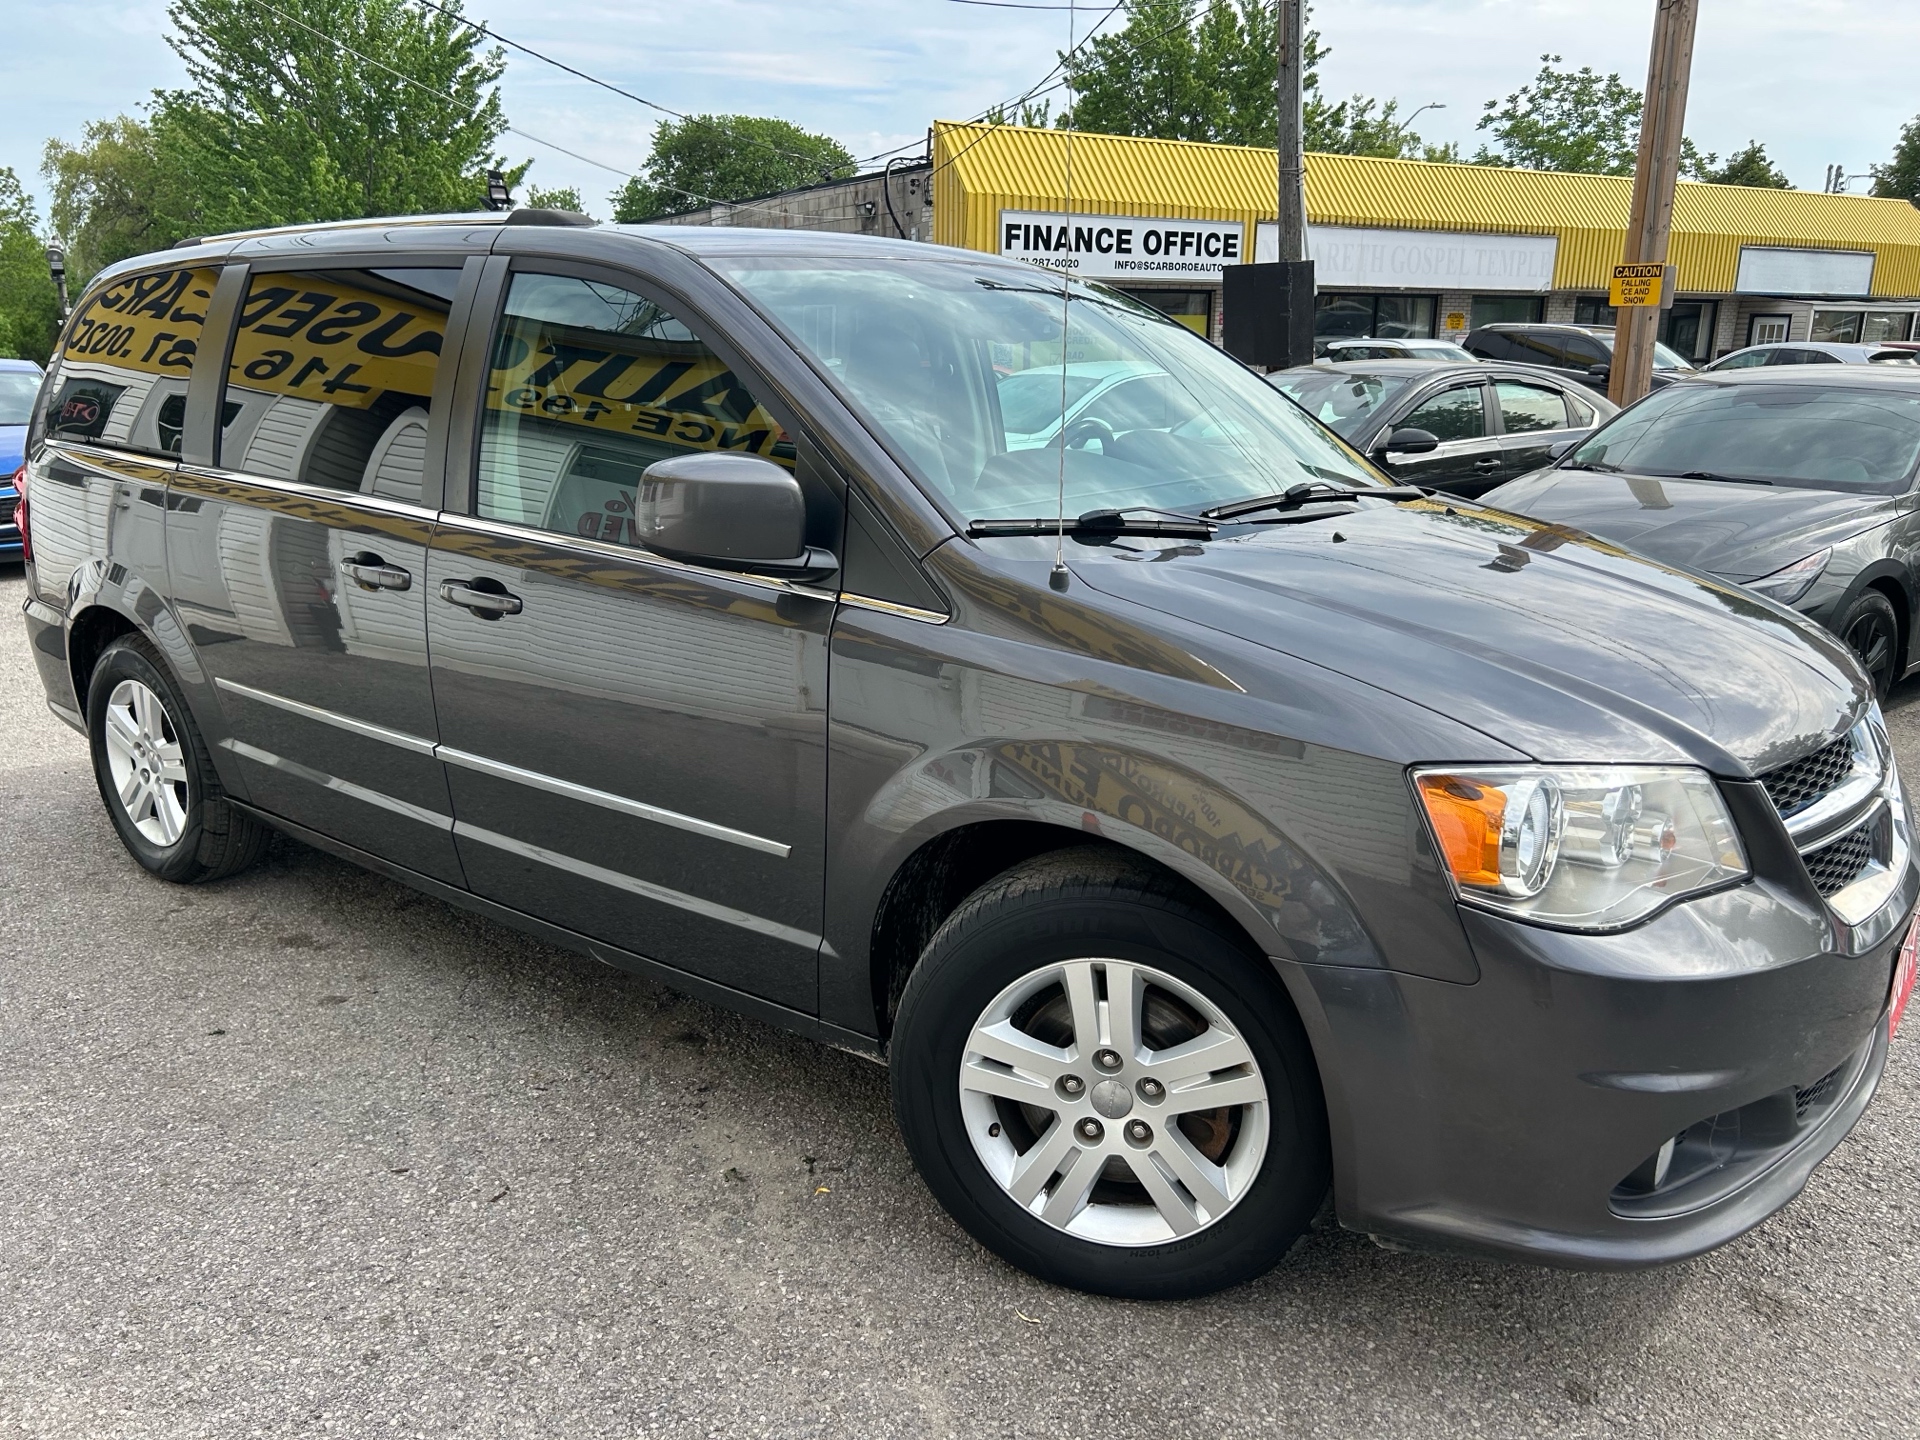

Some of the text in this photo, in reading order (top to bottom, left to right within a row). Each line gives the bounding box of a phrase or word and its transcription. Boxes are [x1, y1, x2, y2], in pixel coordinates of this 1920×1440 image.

[1005, 223, 1239, 258] FINANCE OFFICE
[1114, 260, 1232, 272] INFO@SCARBOROEAUTO
[1391, 245, 1470, 276] GOSPEL
[1475, 250, 1552, 277] TEMPLE
[1615, 266, 1660, 278] CAUTION
[1621, 279, 1651, 287] FALLING
[1621, 288, 1650, 296] ICE AND
[1623, 296, 1646, 305] SNOW
